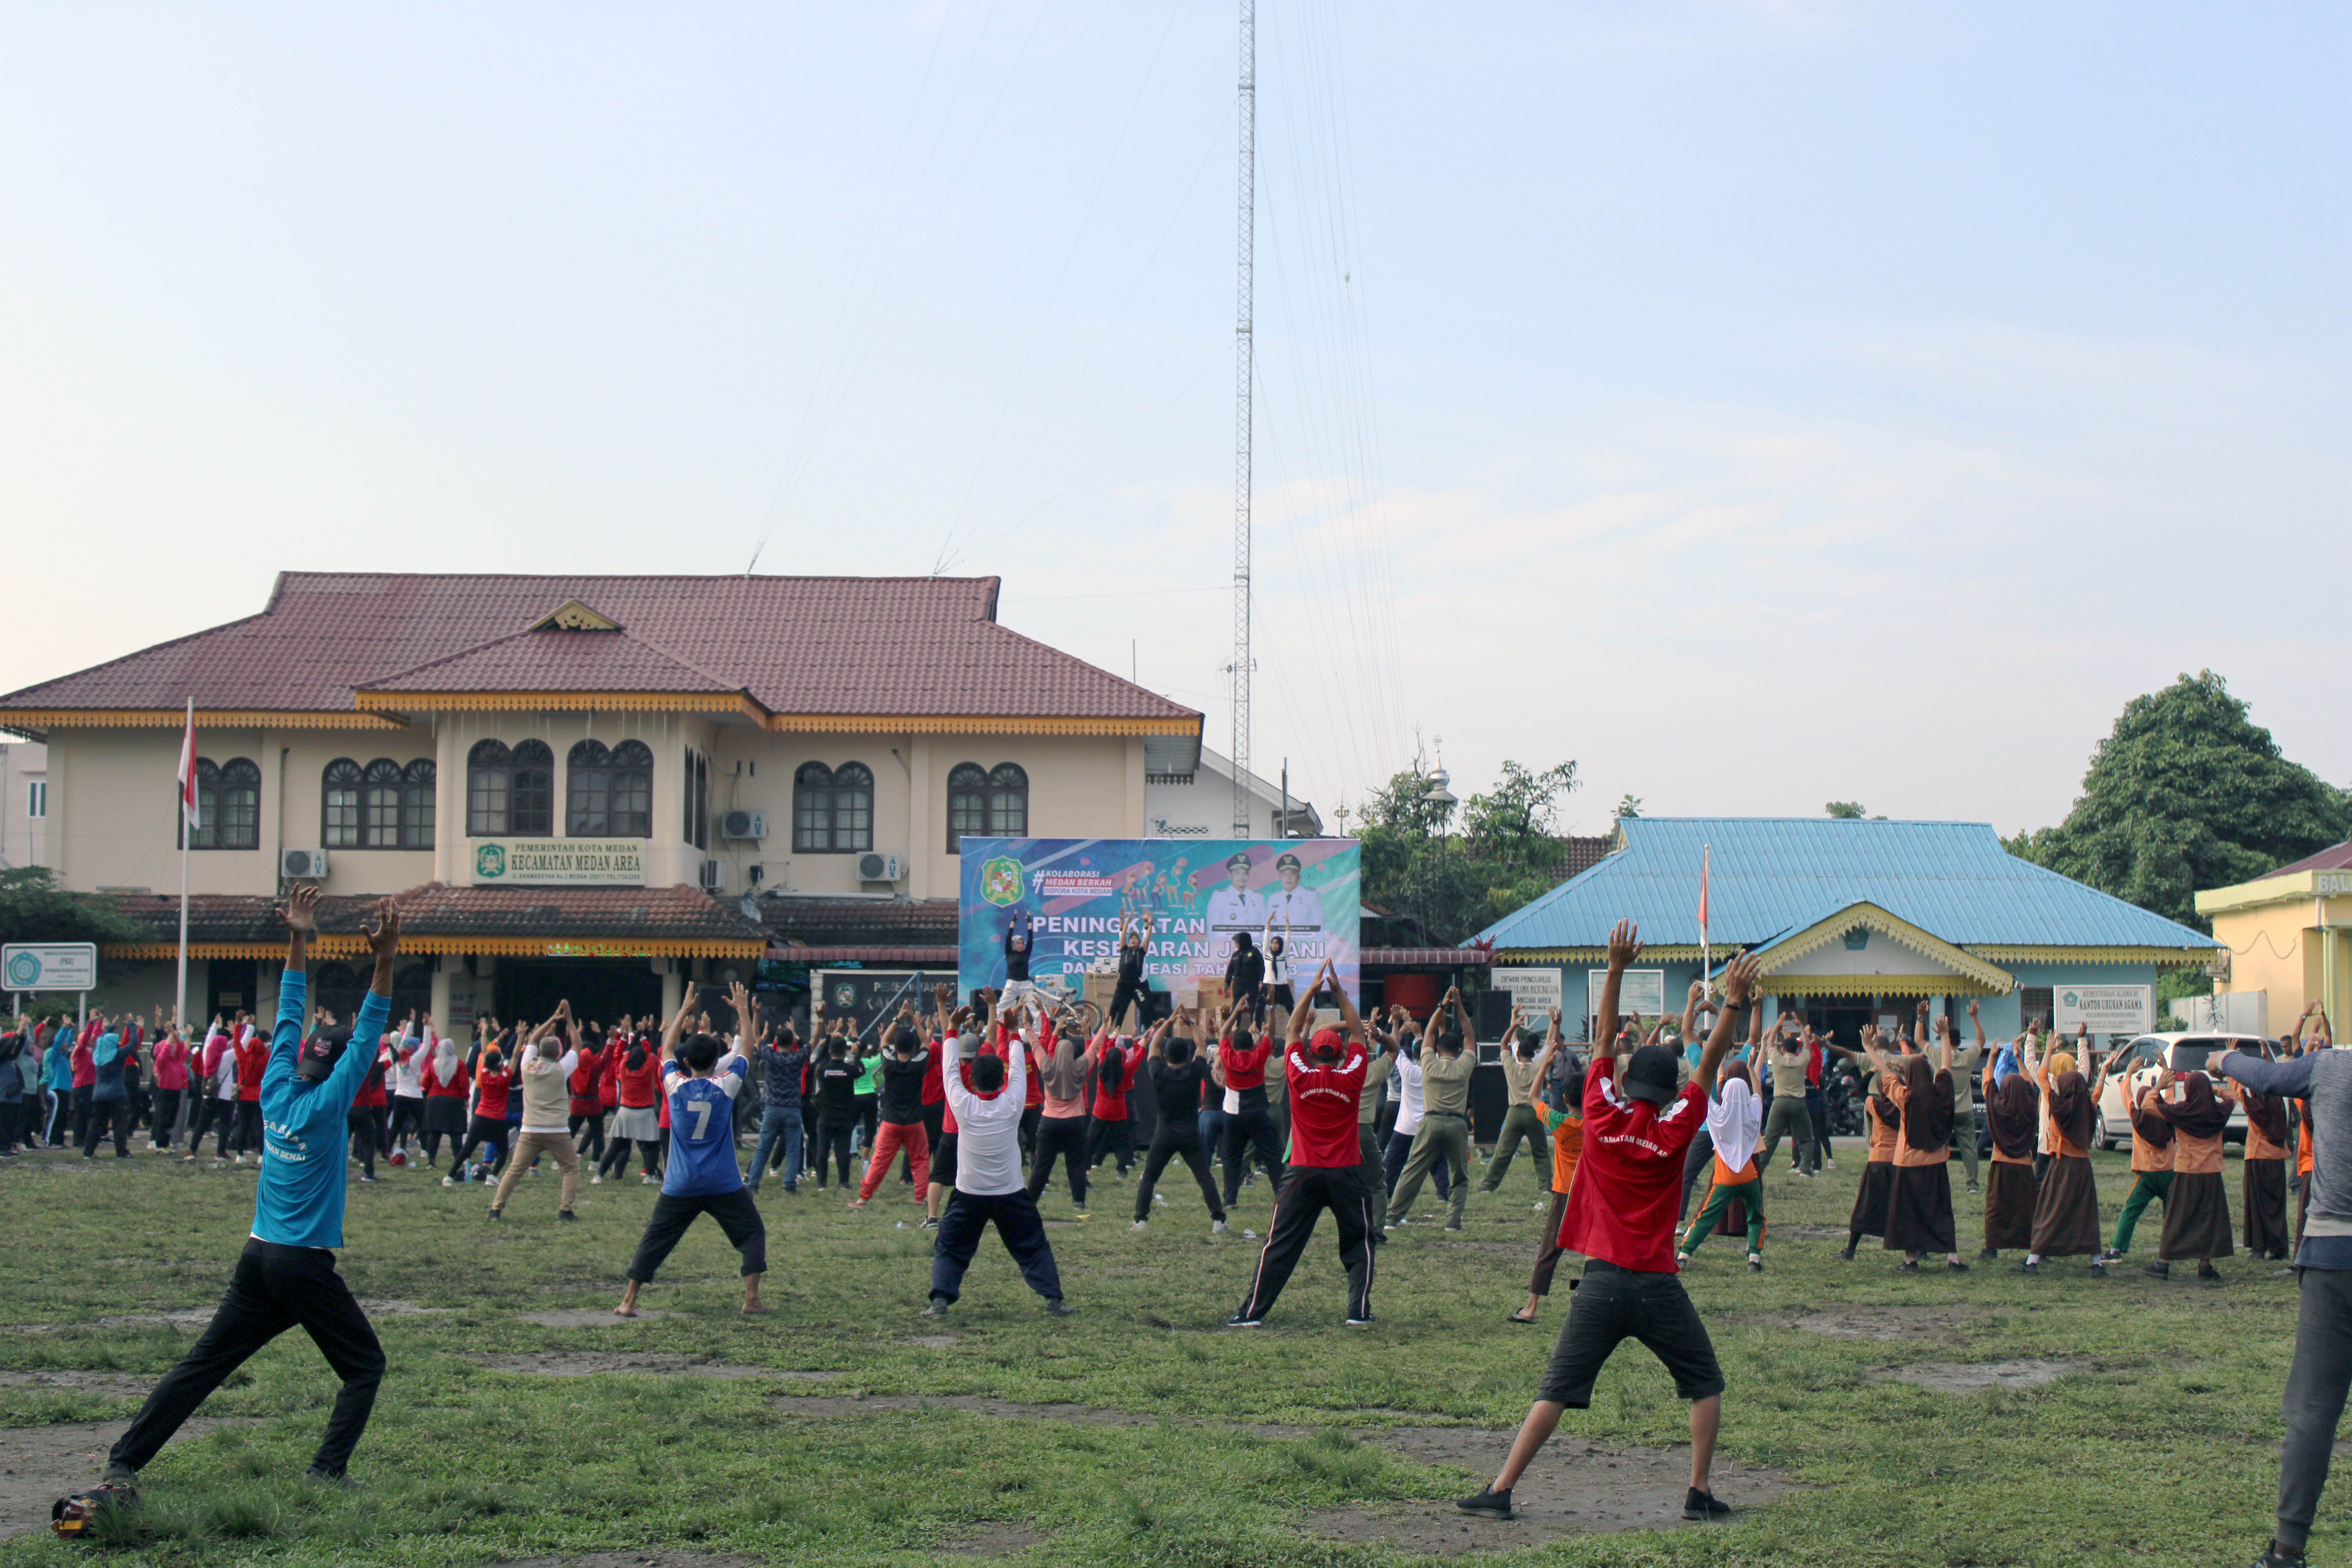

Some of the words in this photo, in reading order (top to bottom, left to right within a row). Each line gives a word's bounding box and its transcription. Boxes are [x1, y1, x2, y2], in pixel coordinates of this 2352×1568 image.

[515, 844, 575, 852] PEMERINTAH
[578, 844, 602, 853] KOTA
[605, 844, 637, 853] MEDAN
[511, 855, 572, 870] KECAMATAN
[575, 855, 610, 871] MEDAN
[613, 856, 641, 871] AREA
[1063, 940, 1210, 957] KESEARAN
[1062, 962, 1091, 974] DA
[1530, 985, 1559, 994] INDONESIA
[2079, 1000, 2101, 1010] KANTOR
[2102, 1000, 2123, 1010] URUSAN
[2123, 1000, 2142, 1010] AGAMA
[1299, 1088, 1325, 1099] KECAMATAN
[1325, 1088, 1340, 1096] MEDAN
[1339, 1093, 1351, 1103] AREA
[687, 1100, 712, 1140] 7
[1598, 1135, 1635, 1143] CAMATAN
[1635, 1138, 1658, 1152] MEDAN
[280, 1151, 306, 1161] DENAI
